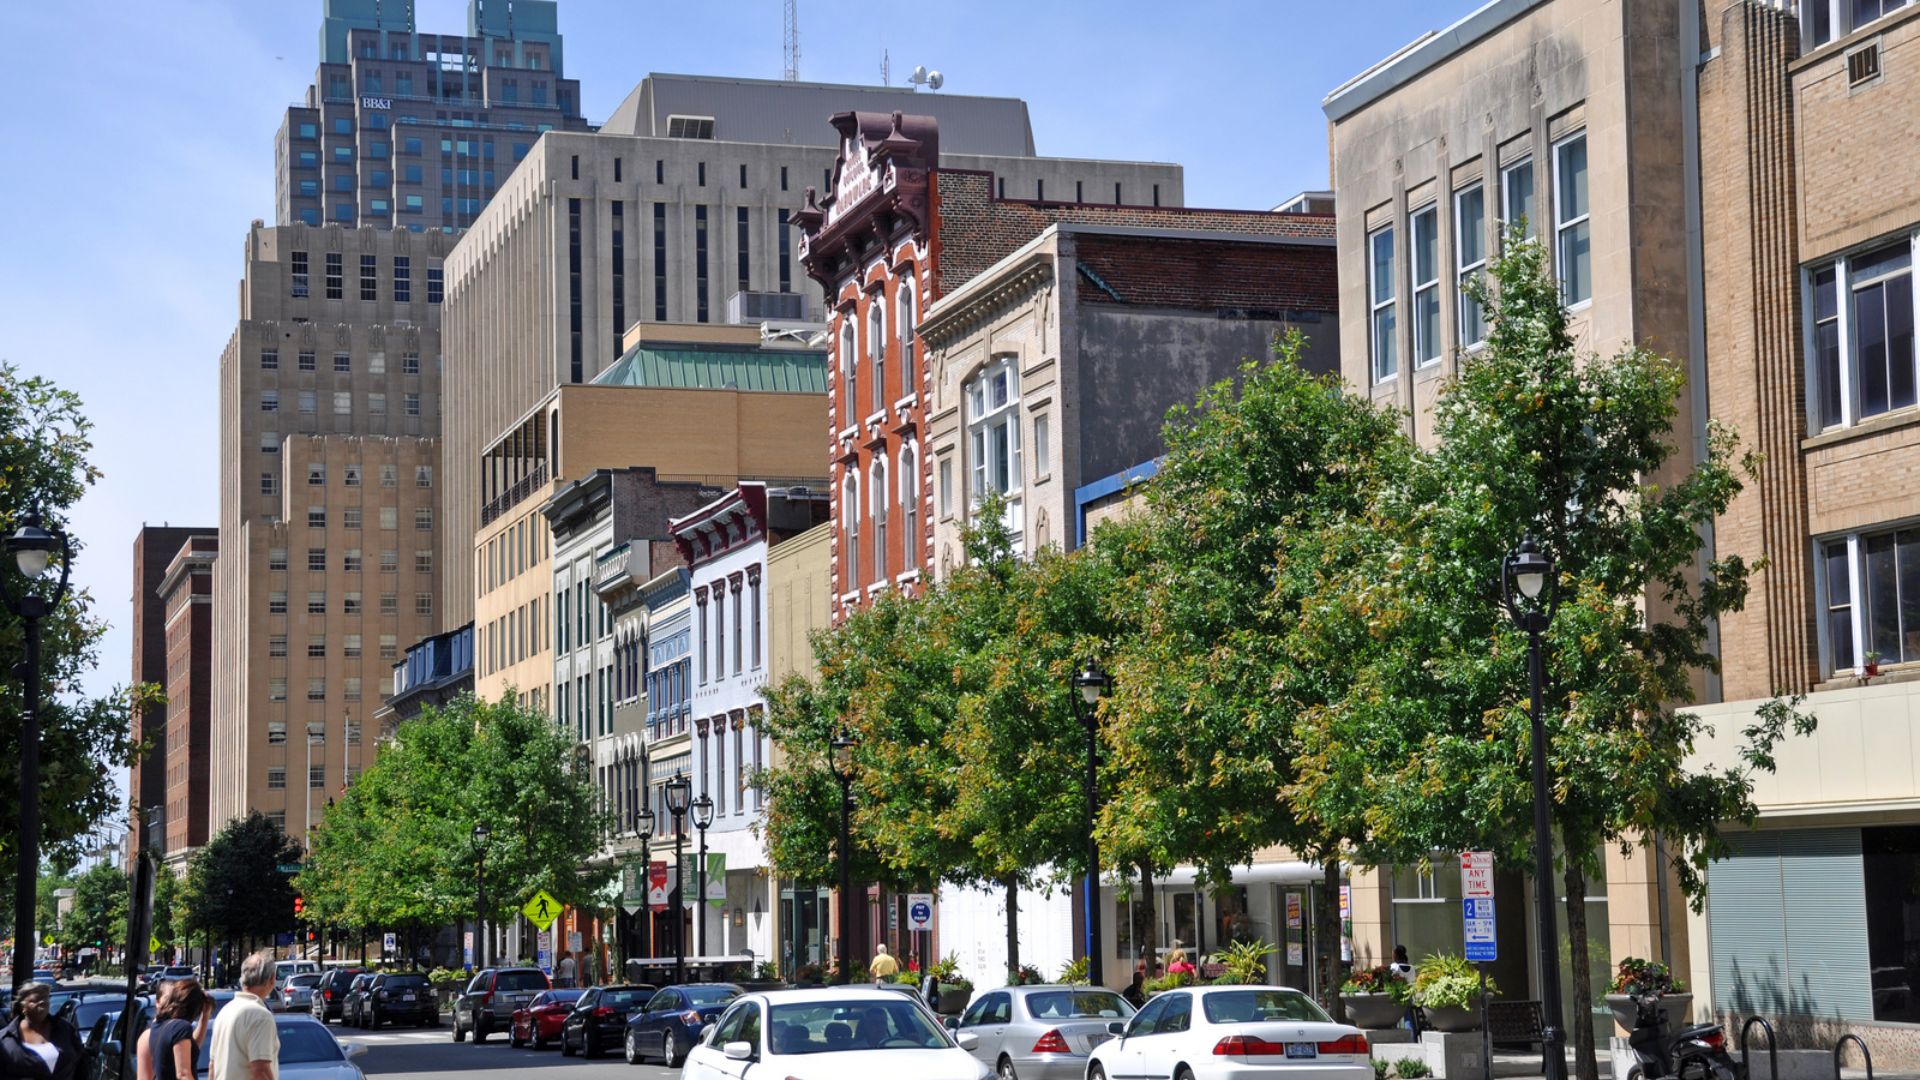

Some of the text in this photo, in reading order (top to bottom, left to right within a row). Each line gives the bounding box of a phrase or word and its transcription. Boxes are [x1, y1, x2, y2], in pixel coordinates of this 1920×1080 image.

[363, 97, 392, 109] BB&T
[1469, 870, 1485, 878] ANY
[1468, 880, 1488, 889] TIME
[1466, 902, 1473, 917] 2
